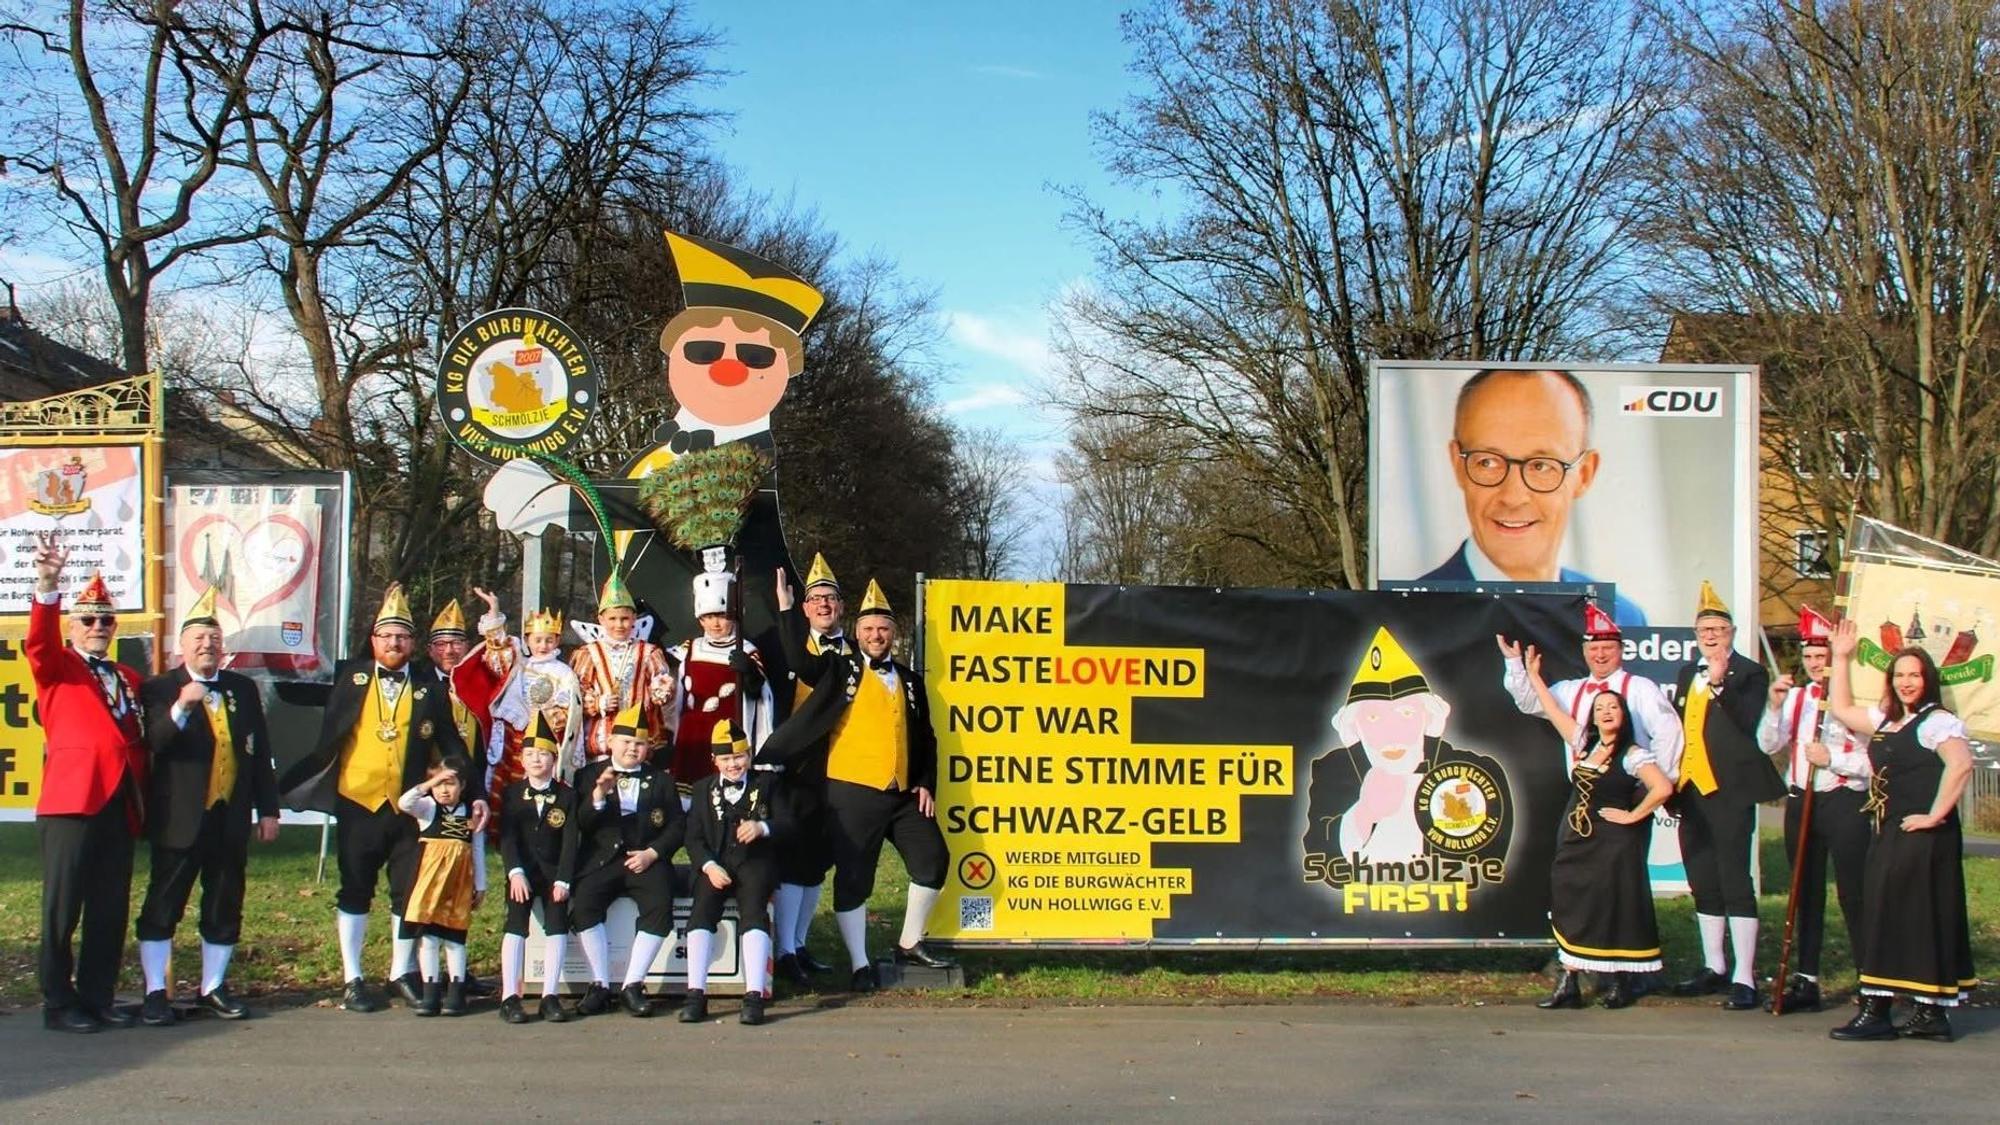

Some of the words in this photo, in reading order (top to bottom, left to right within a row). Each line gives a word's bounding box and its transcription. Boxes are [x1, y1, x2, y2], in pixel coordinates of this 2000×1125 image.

[452, 337, 478, 367] DIE
[476, 316, 587, 377] BURGWÄCHTER
[518, 351, 541, 364] 2007
[446, 371, 464, 393] KG
[1647, 391, 1717, 412] CDU
[459, 423, 488, 452] VUN
[562, 407, 589, 435] E.V.
[950, 605, 1053, 634] MAKE
[949, 655, 1197, 686] FASTELOVEND
[949, 705, 1024, 733] NOT
[1035, 707, 1120, 735] WAR
[949, 755, 1053, 783] DEINE
[1065, 757, 1206, 785] STIMME
[1217, 751, 1285, 786] FÜR
[946, 805, 1228, 836] SCHWARZ-GELB
[1006, 851, 1062, 865] WERDE
[1067, 852, 1141, 865] MITGLIED
[1303, 851, 1505, 889] Schmölzje
[1008, 875, 1029, 889] KG
[1034, 876, 1059, 889] DIE
[1065, 873, 1187, 889] BURGWÄCHTER
[1007, 898, 1043, 911] VUN
[1048, 898, 1133, 911] HOLLWIGG
[1138, 899, 1164, 911] E.V.
[1343, 882, 1468, 914] FIRST!
